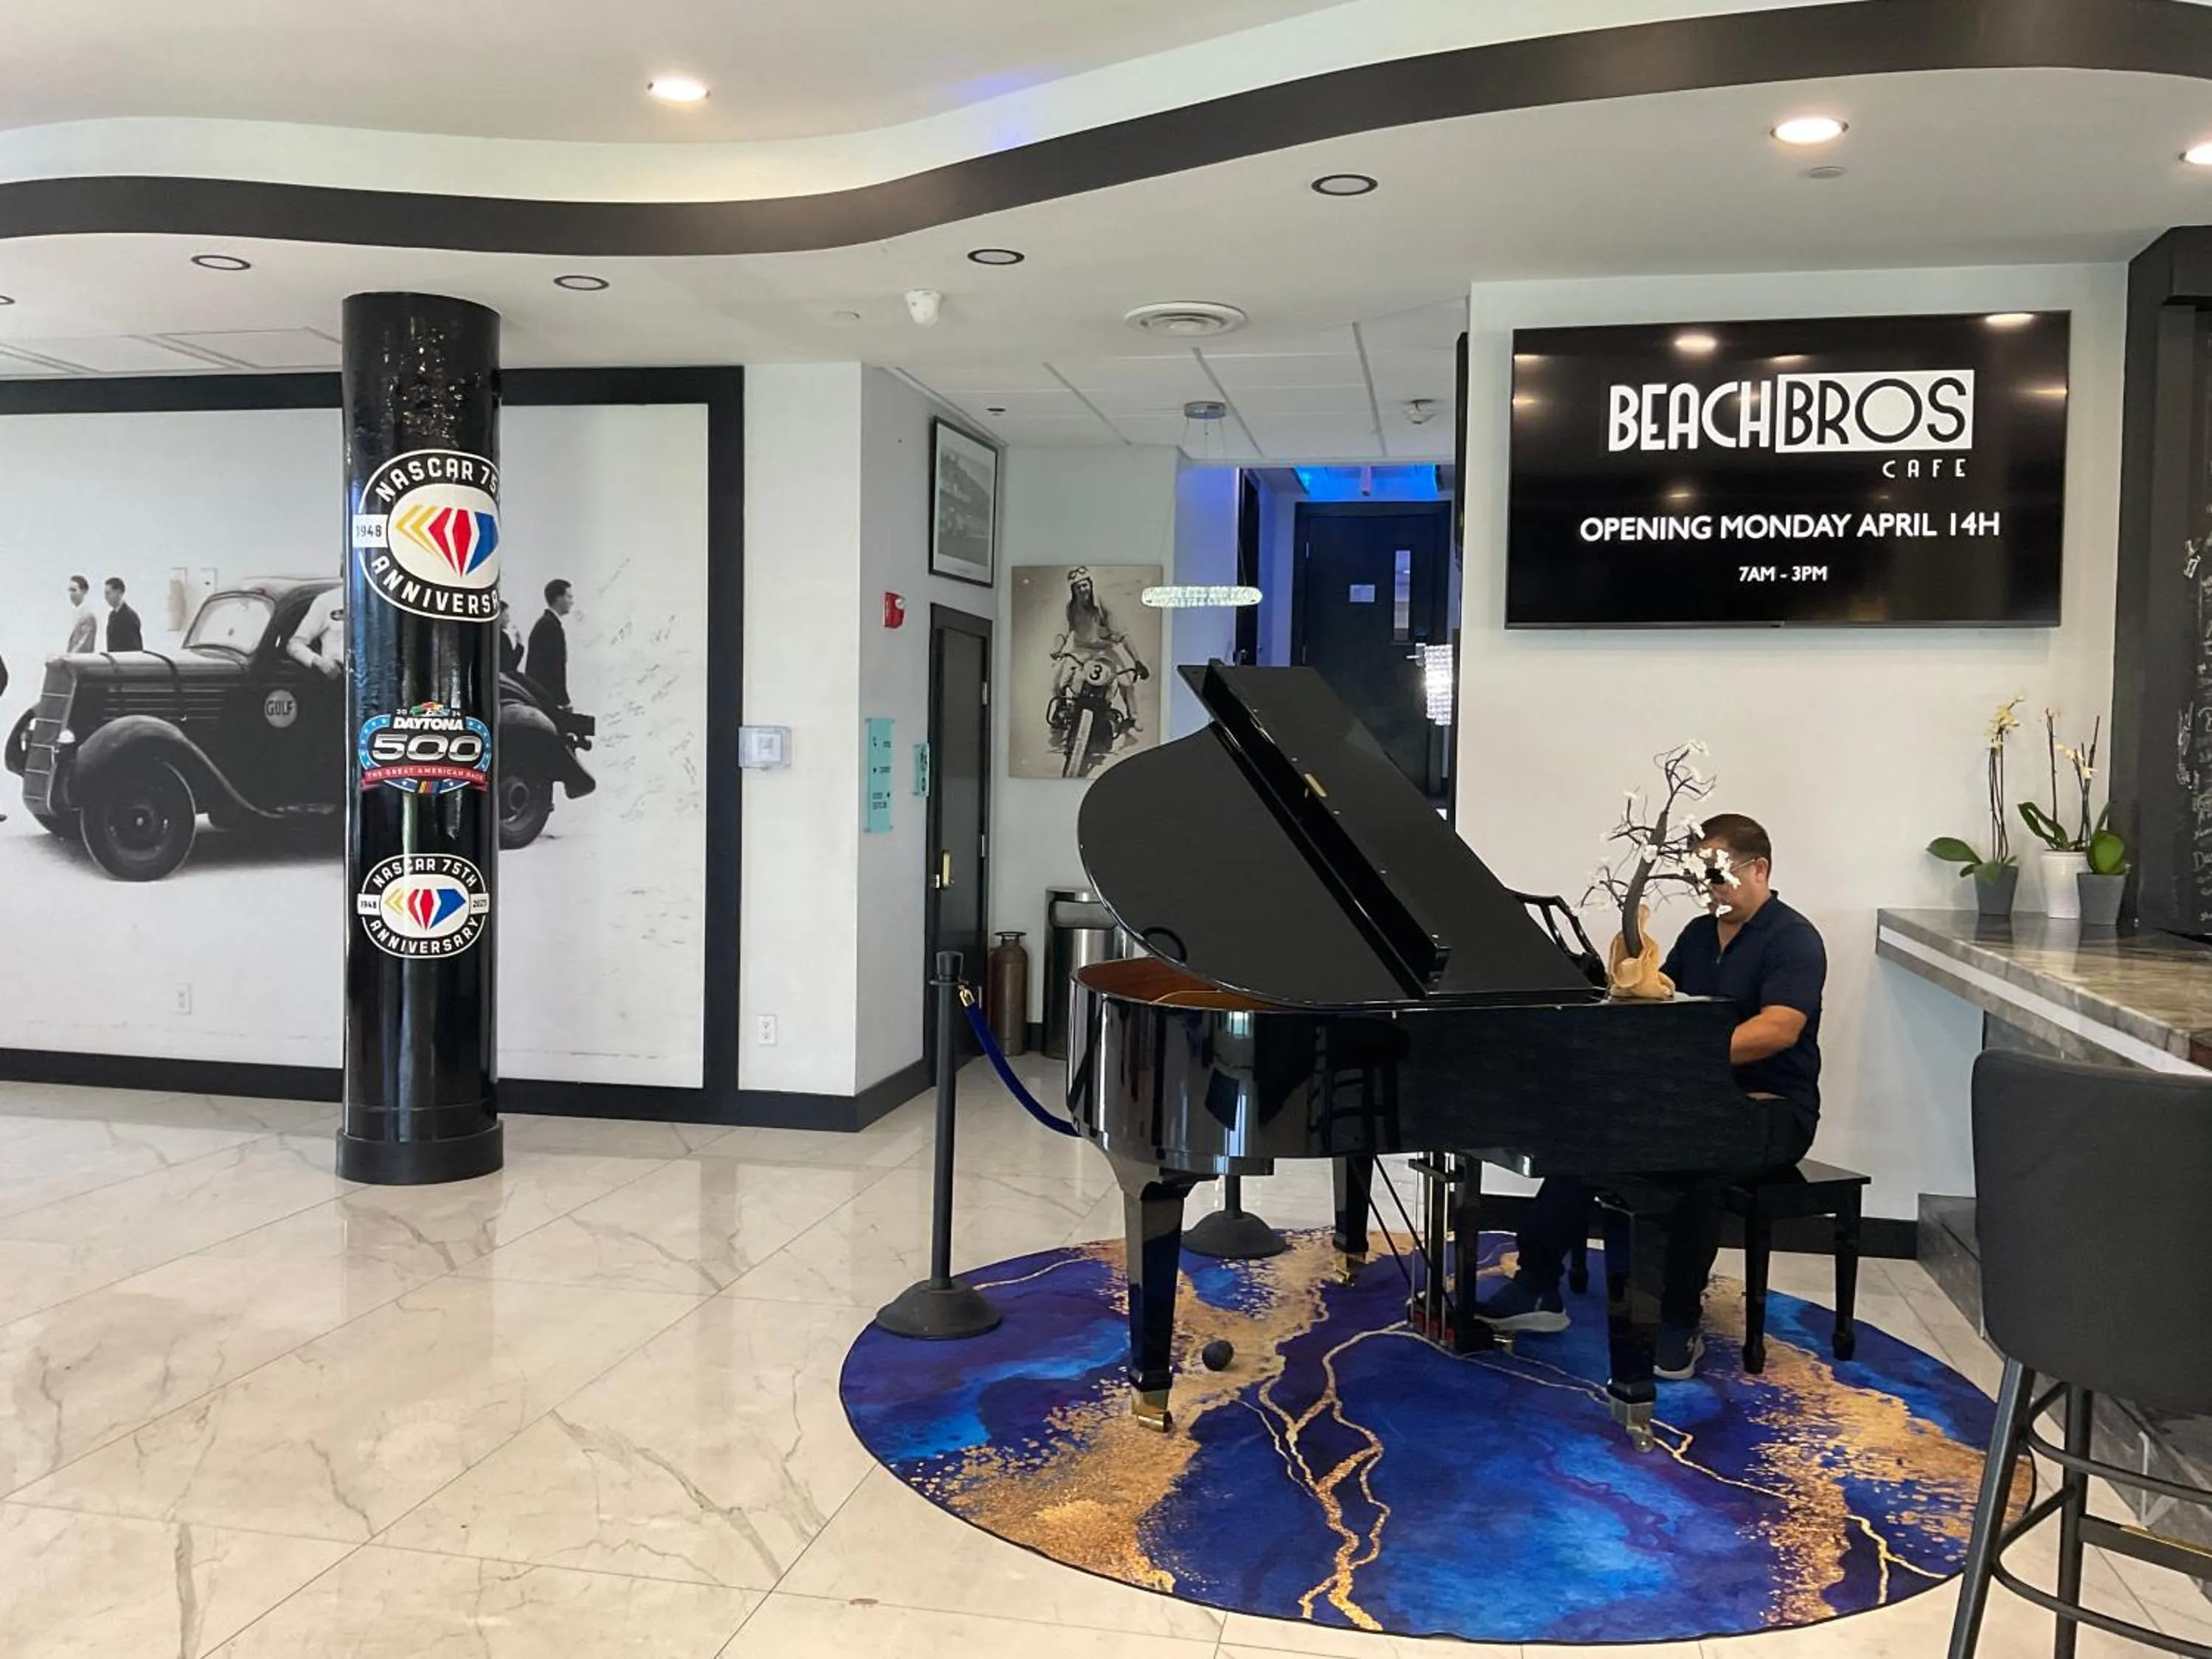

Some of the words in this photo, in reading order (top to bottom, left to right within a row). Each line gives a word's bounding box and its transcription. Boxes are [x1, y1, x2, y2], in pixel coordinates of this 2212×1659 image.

[1608, 380, 1771, 452] BEACH
[1784, 377, 1966, 446] BROS
[1882, 459, 1966, 479] CAFE
[375, 457, 473, 502] NASCAR
[356, 524, 382, 538] 1948
[1580, 515, 1711, 542] OPENING
[1720, 513, 1852, 540] MONDAY
[1857, 512, 1938, 538] APRIL
[1950, 511, 2000, 537] 14H
[1739, 566, 1777, 582] 7AM
[1791, 566, 1828, 582] 3PM
[1088, 664, 1103, 681] 3
[267, 700, 293, 716] GULF
[393, 716, 464, 731] DAYTONA
[372, 734, 483, 762] 500
[386, 768, 414, 776] GREAT
[417, 767, 464, 776] AMERICAN
[372, 858, 436, 888] NASCAR
[442, 859, 477, 887] 75TH
[361, 900, 377, 909] 1948
[370, 917, 479, 954] ANNIVERSARY
